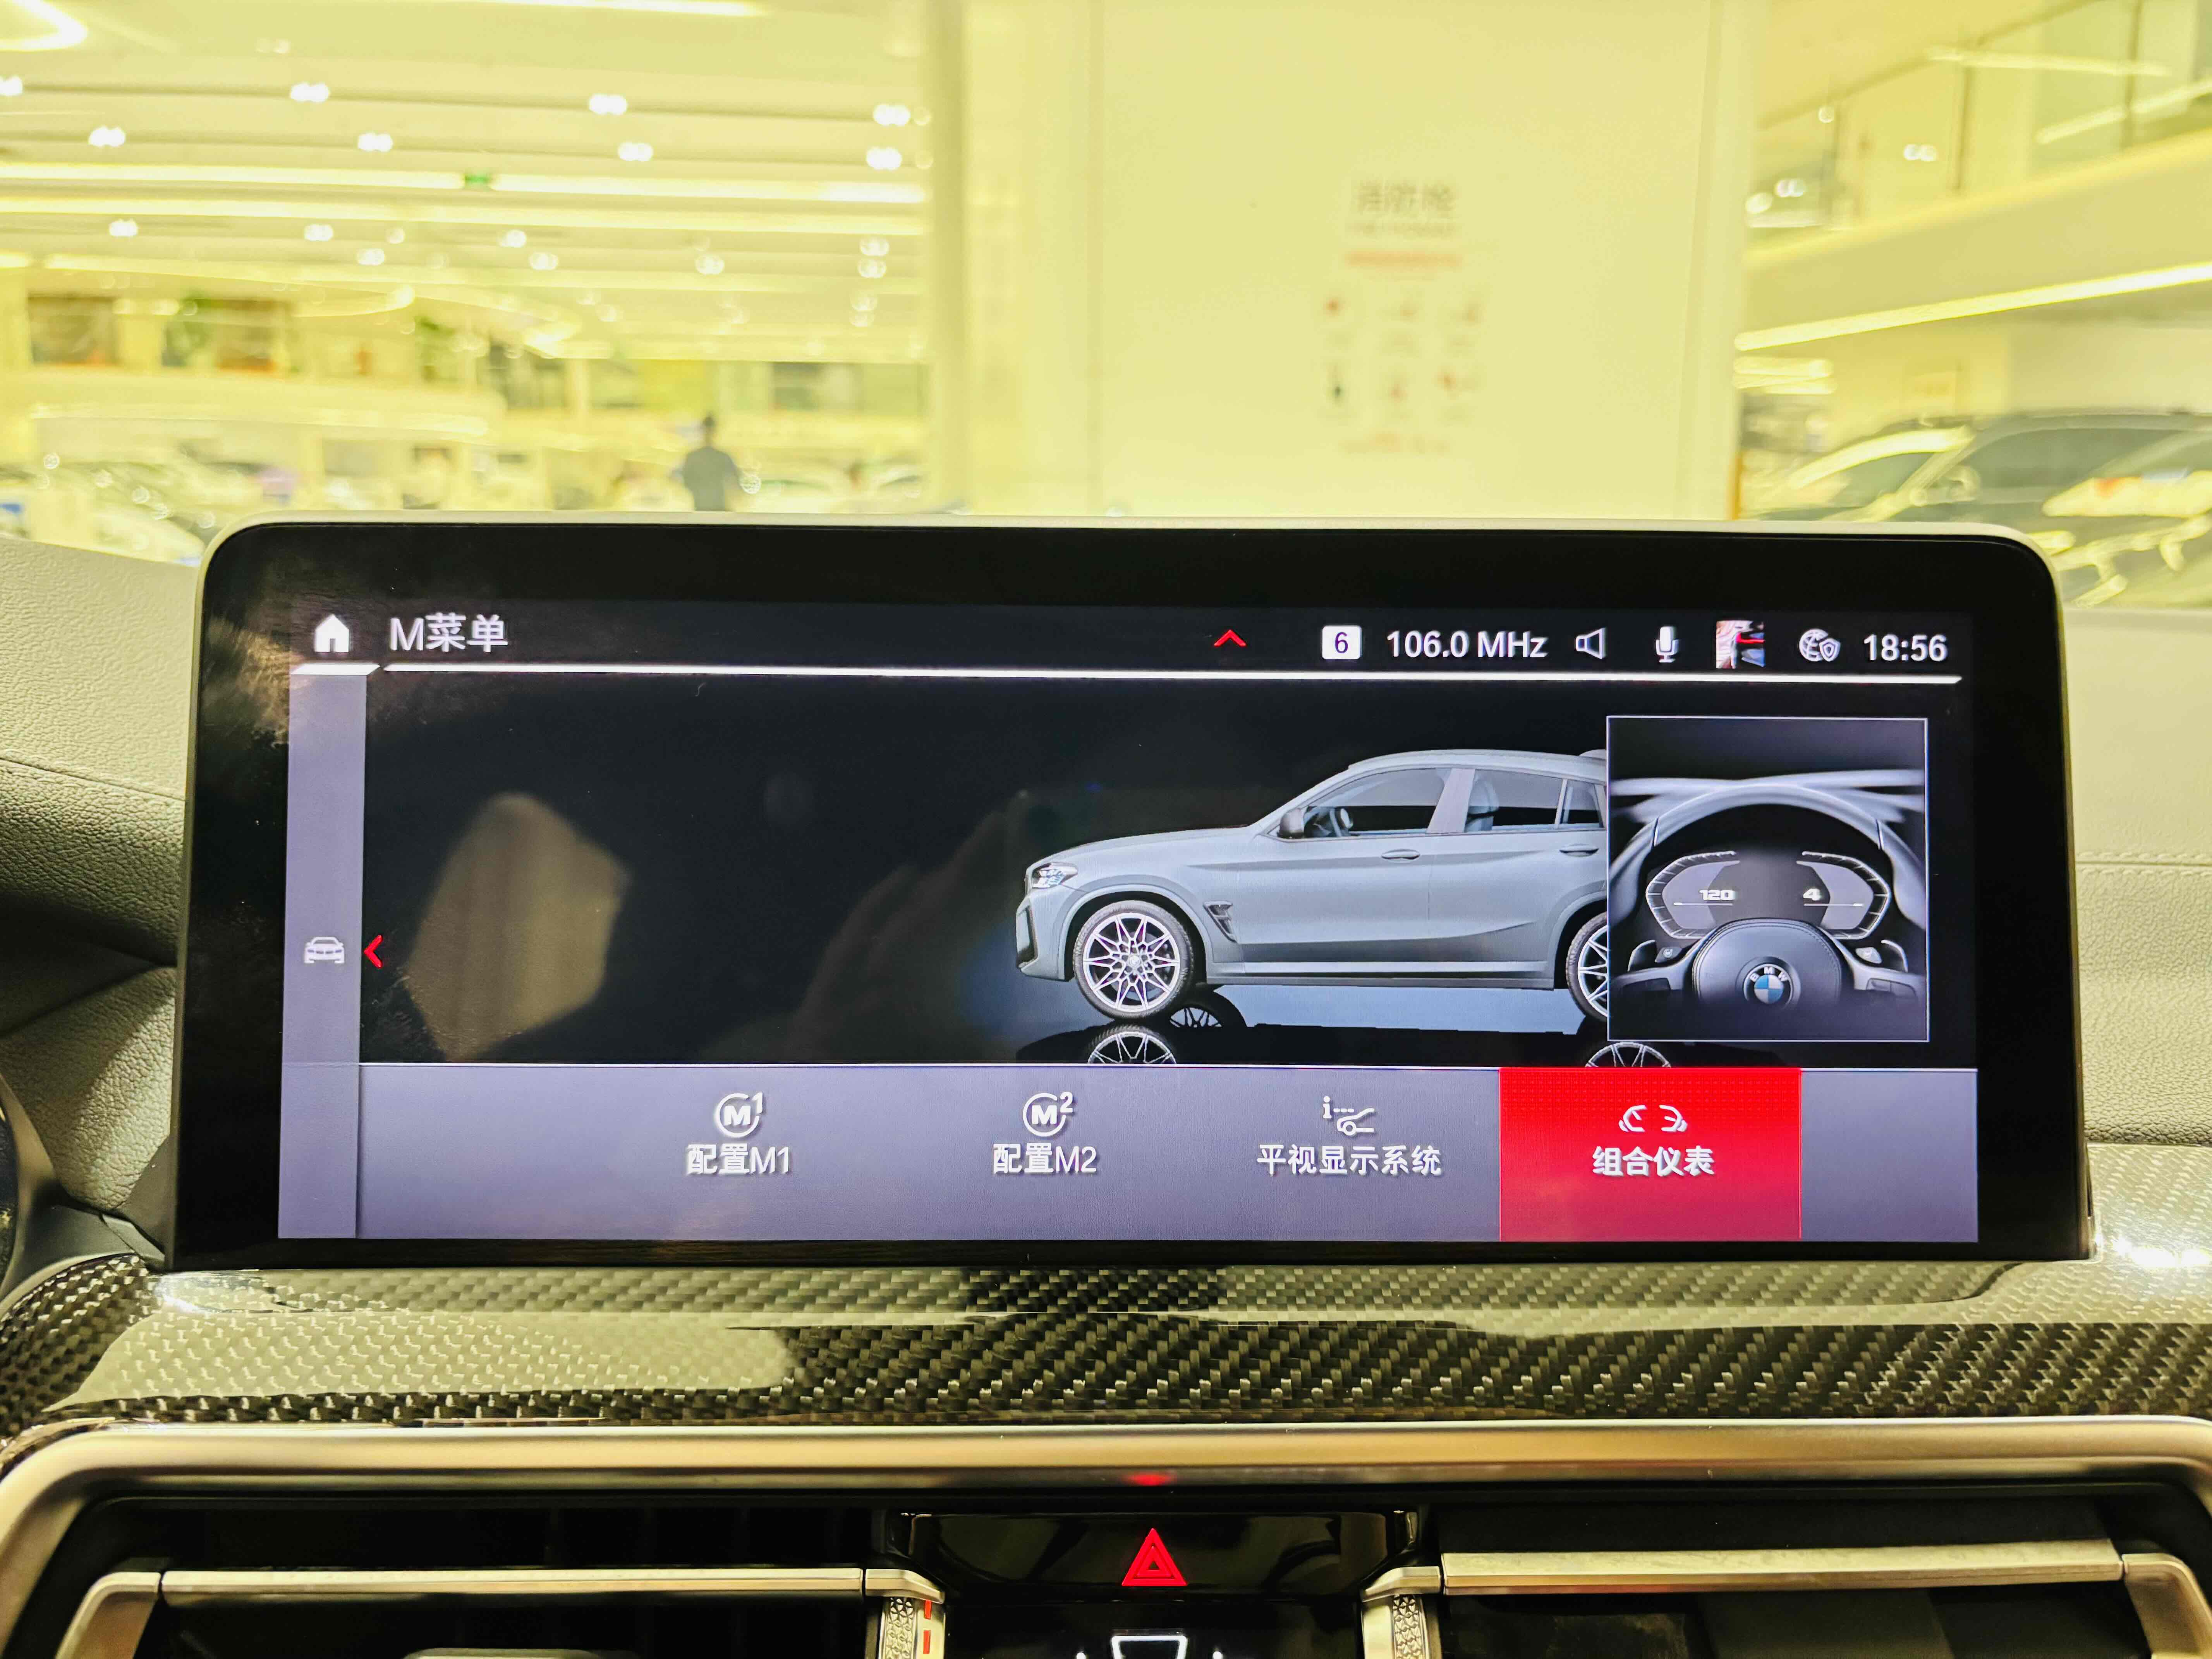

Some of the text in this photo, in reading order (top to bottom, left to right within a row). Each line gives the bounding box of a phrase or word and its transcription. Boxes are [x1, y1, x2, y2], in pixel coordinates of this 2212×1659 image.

[390, 612, 508, 653] M菜单
[1334, 632, 1348, 653] 6
[1386, 630, 1549, 658] 106.0 MHz
[1863, 634, 1947, 661] 18:56
[1699, 890, 1735, 901] 120
[1803, 888, 1821, 901] 4
[1750, 967, 1788, 982] BMW
[686, 1144, 789, 1175] 配置M1
[993, 1142, 1097, 1174] 配置M2
[1257, 1144, 1441, 1175] 平视显示系统
[1592, 1146, 1714, 1176] 组合仪表
